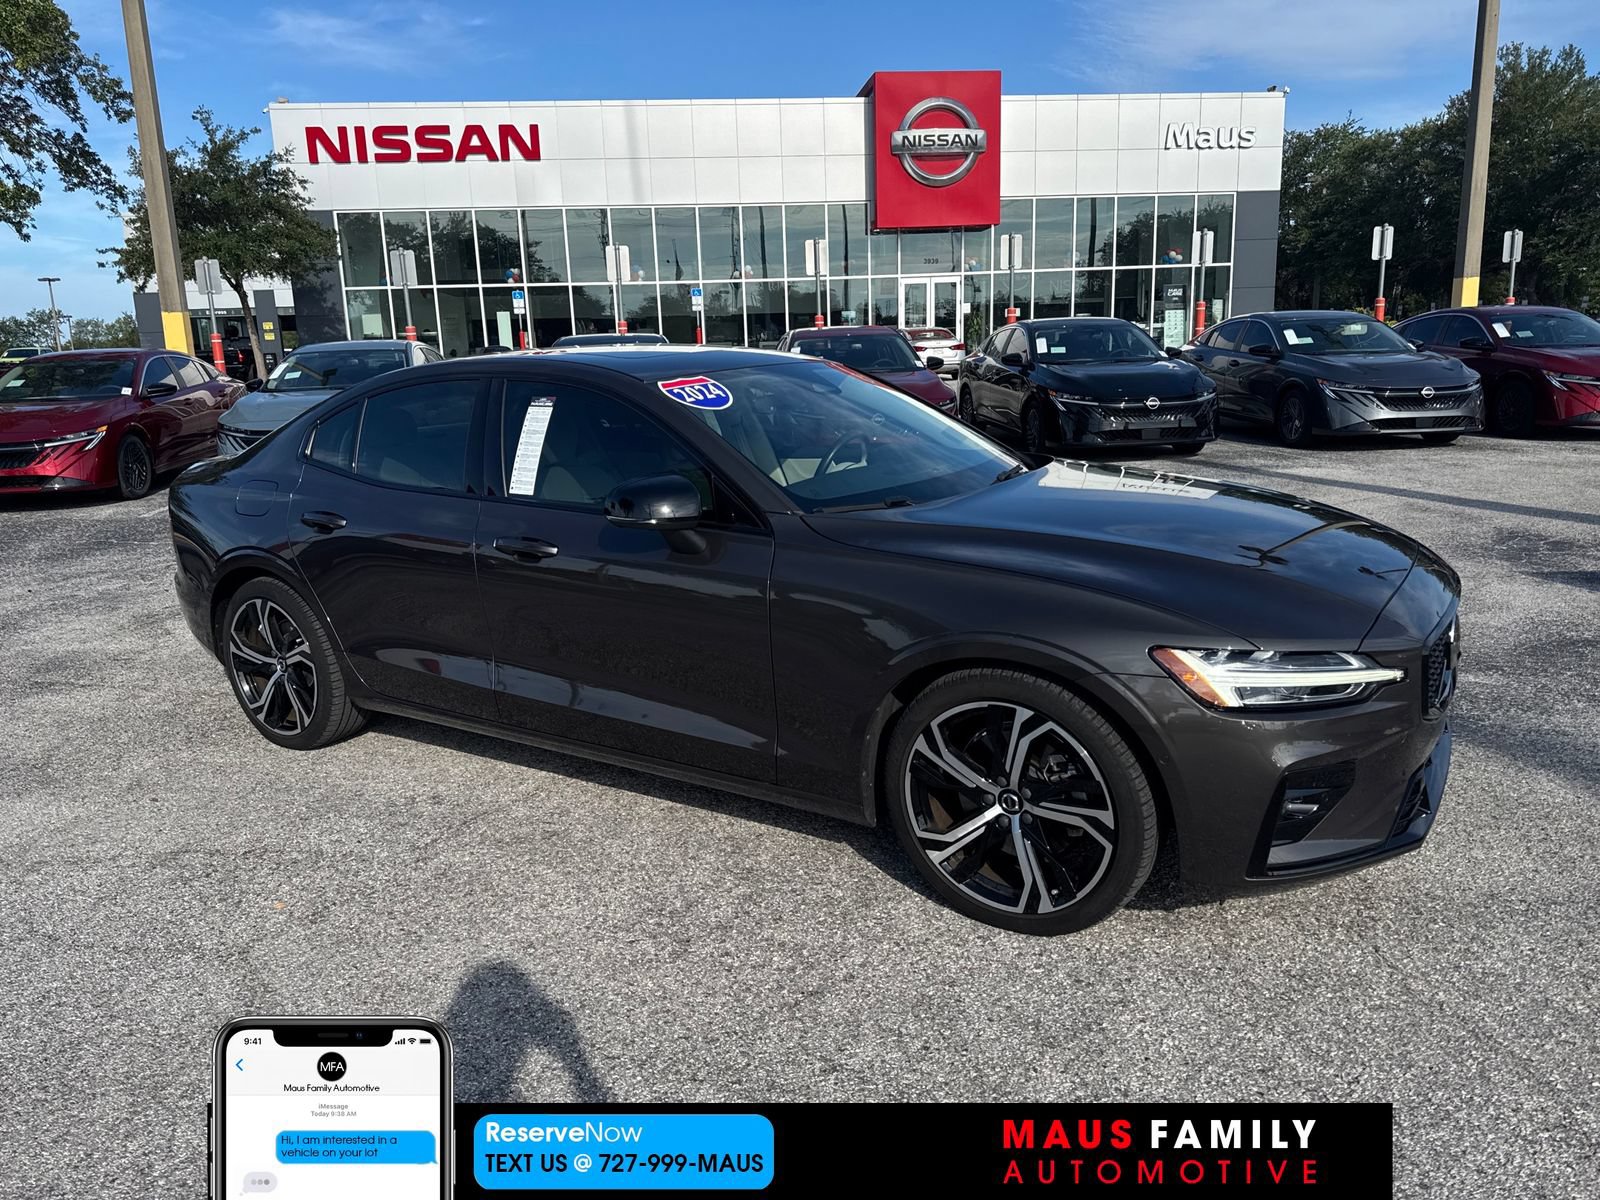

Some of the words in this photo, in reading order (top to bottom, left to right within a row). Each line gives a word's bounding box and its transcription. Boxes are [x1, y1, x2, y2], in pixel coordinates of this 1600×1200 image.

[305, 124, 541, 164] NISSAN
[902, 134, 978, 148] NISSAN
[1164, 122, 1257, 150] Maus
[673, 384, 726, 402] 2024
